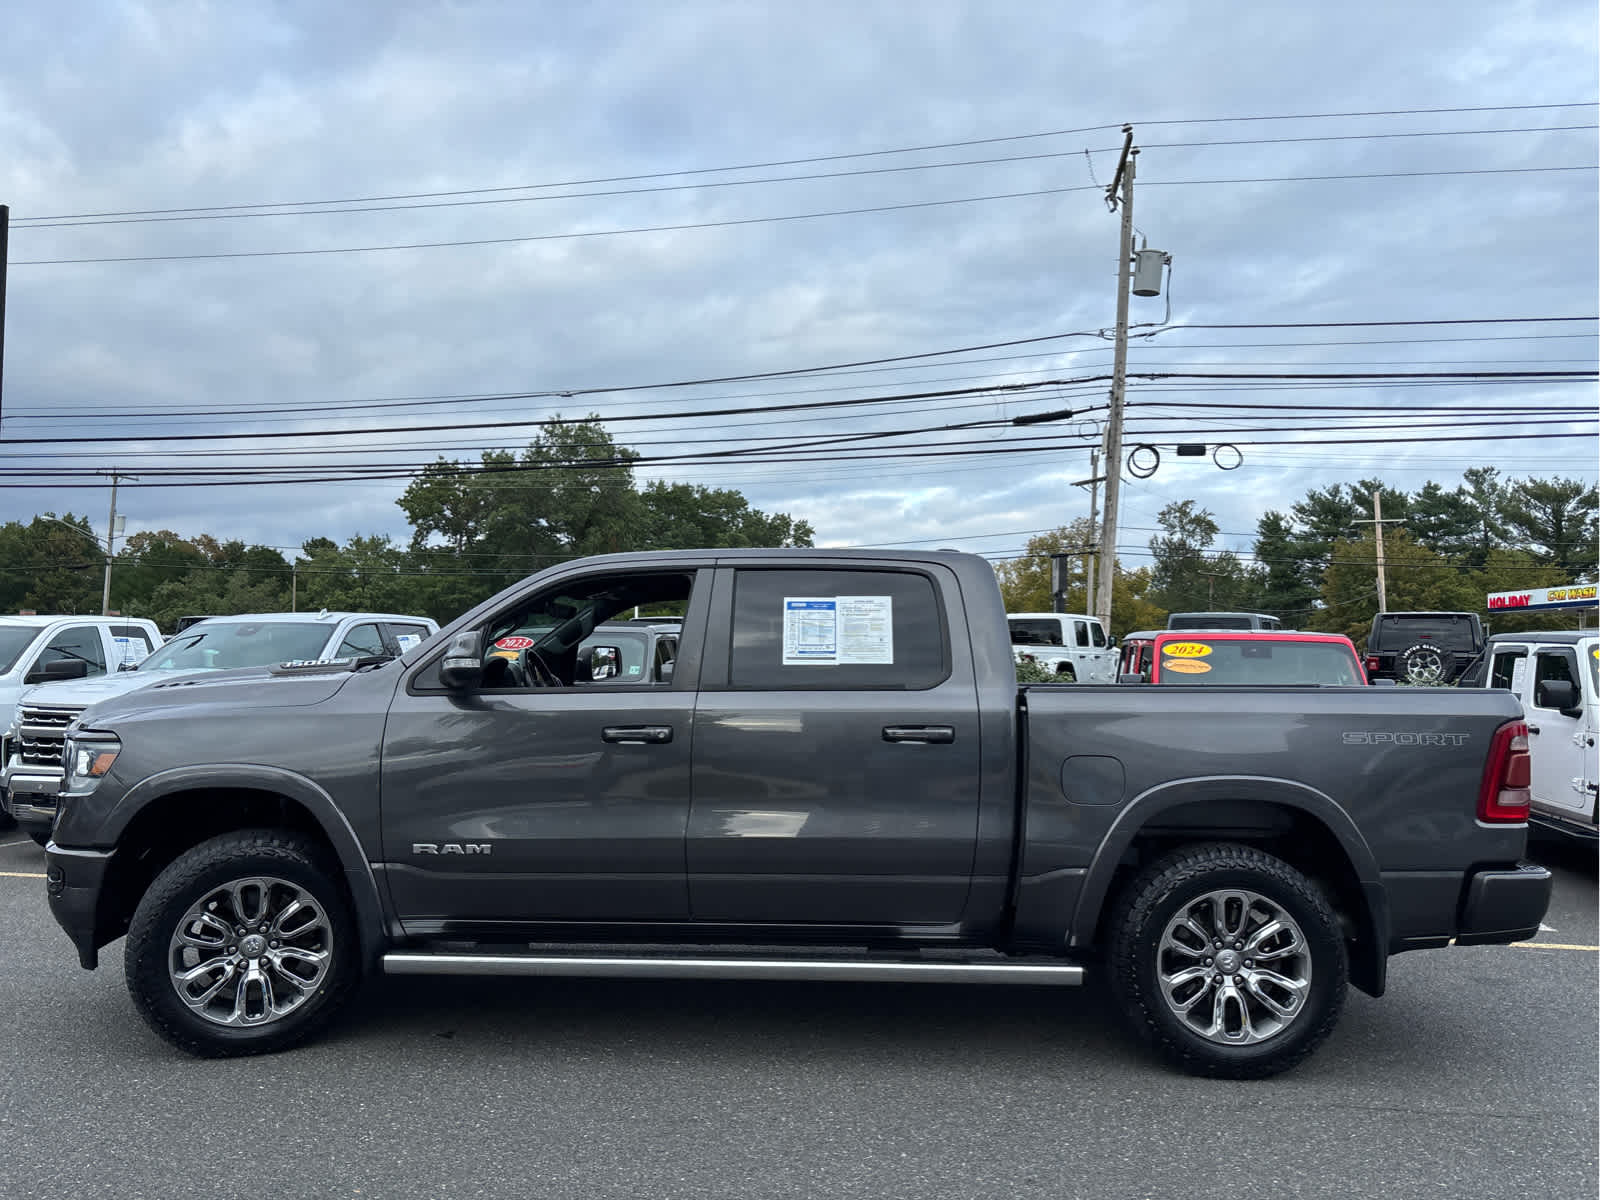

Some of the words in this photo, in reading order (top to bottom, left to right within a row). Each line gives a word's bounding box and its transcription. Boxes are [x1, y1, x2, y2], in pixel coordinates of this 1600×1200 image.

[1489, 594, 1531, 609] HOLIDAY
[1547, 590, 1567, 601] CAR
[1568, 587, 1597, 600] WASH
[501, 639, 529, 648] 2023
[1170, 645, 1205, 655] 2024
[1342, 731, 1470, 746] SPORT
[412, 843, 492, 855] RAM
